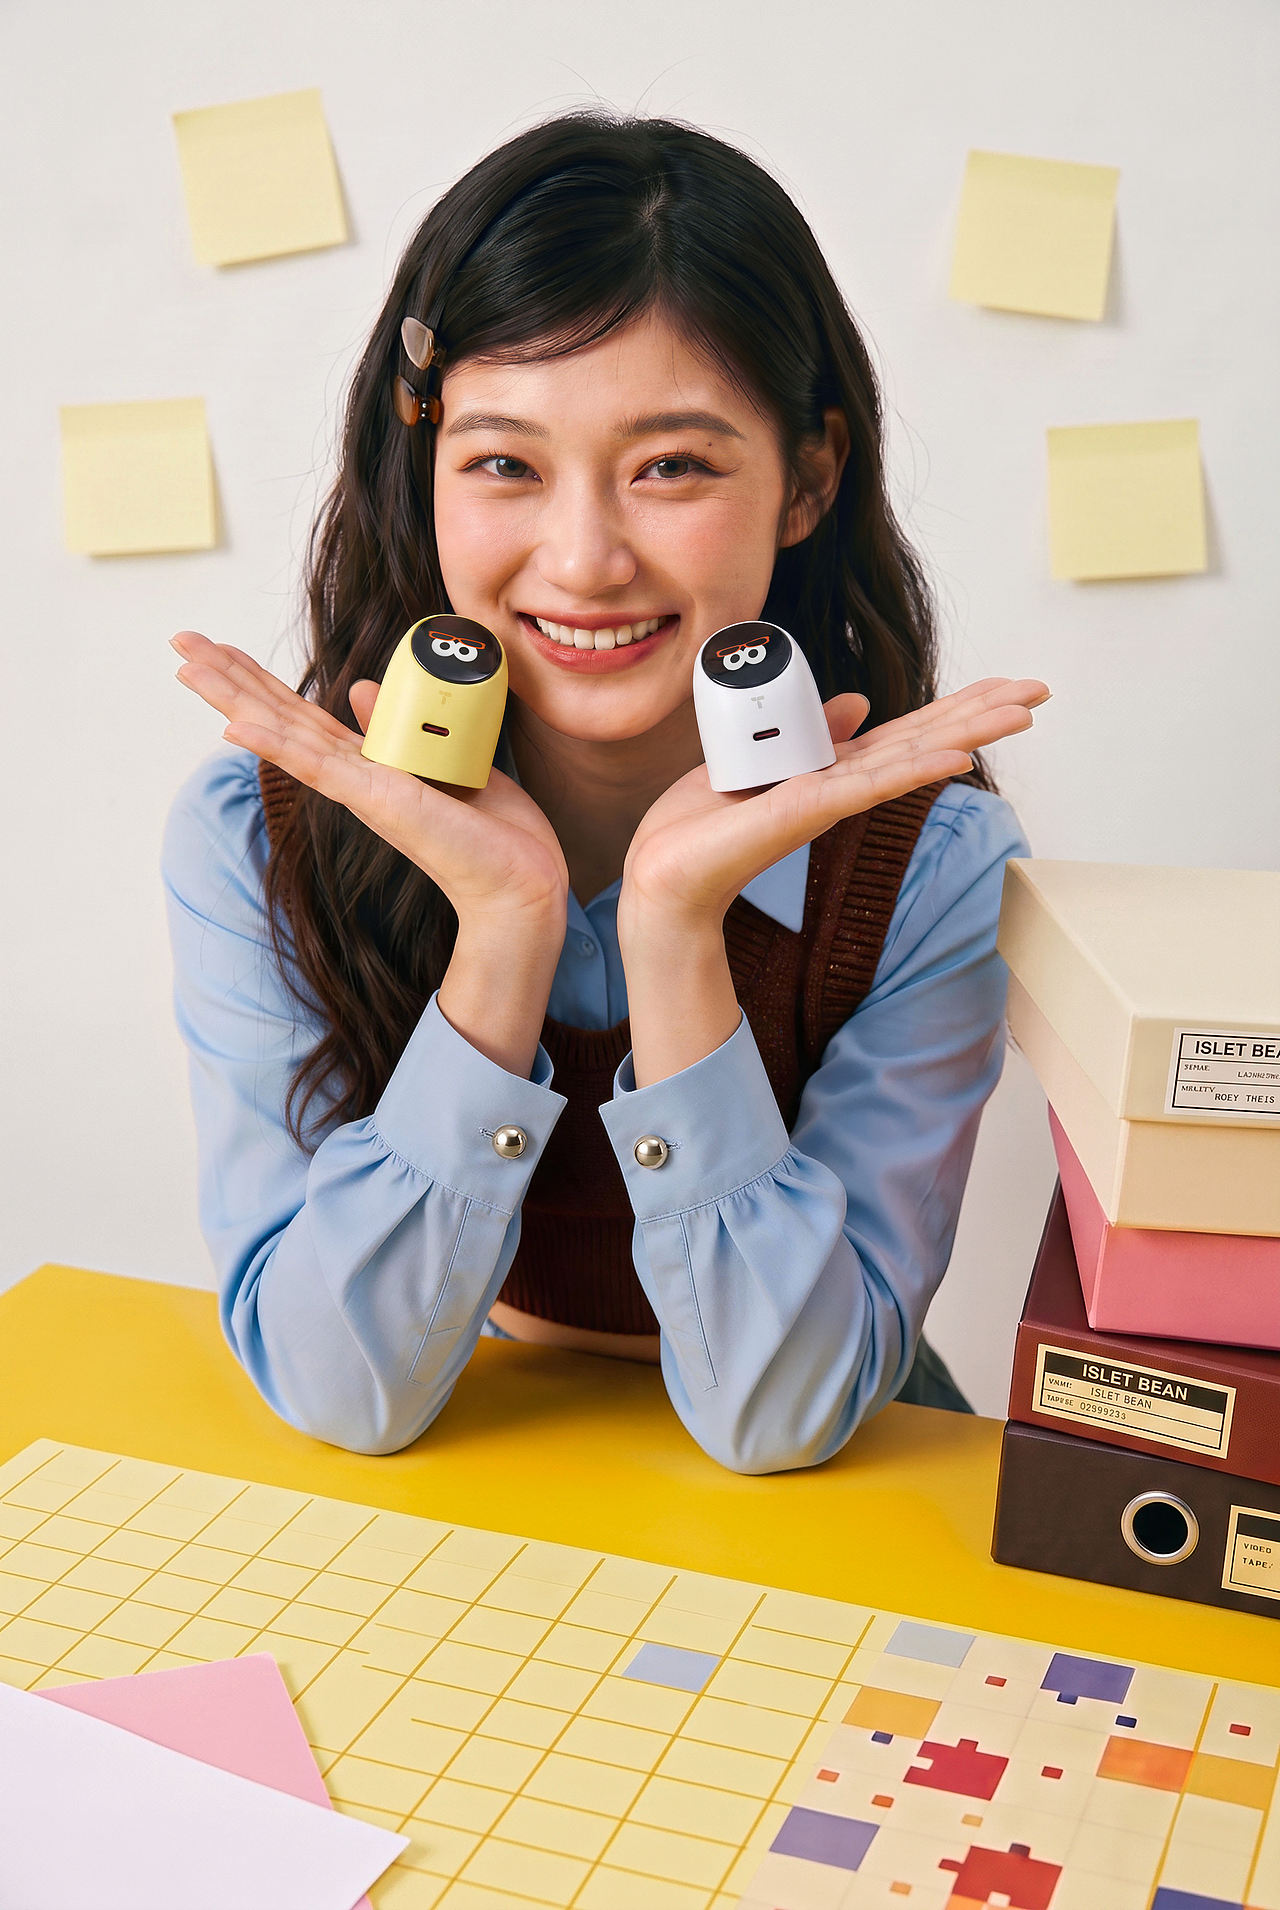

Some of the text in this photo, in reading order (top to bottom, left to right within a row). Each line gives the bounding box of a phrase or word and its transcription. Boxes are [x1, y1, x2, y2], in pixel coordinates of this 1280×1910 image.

[1195, 1041, 1247, 1056] ISLET
[1214, 1093, 1275, 1104] ROEY THEIS
[1082, 1364, 1188, 1400] ISLET BEAN
[1091, 1387, 1120, 1401] ISLET
[1124, 1395, 1152, 1409] BEAN
